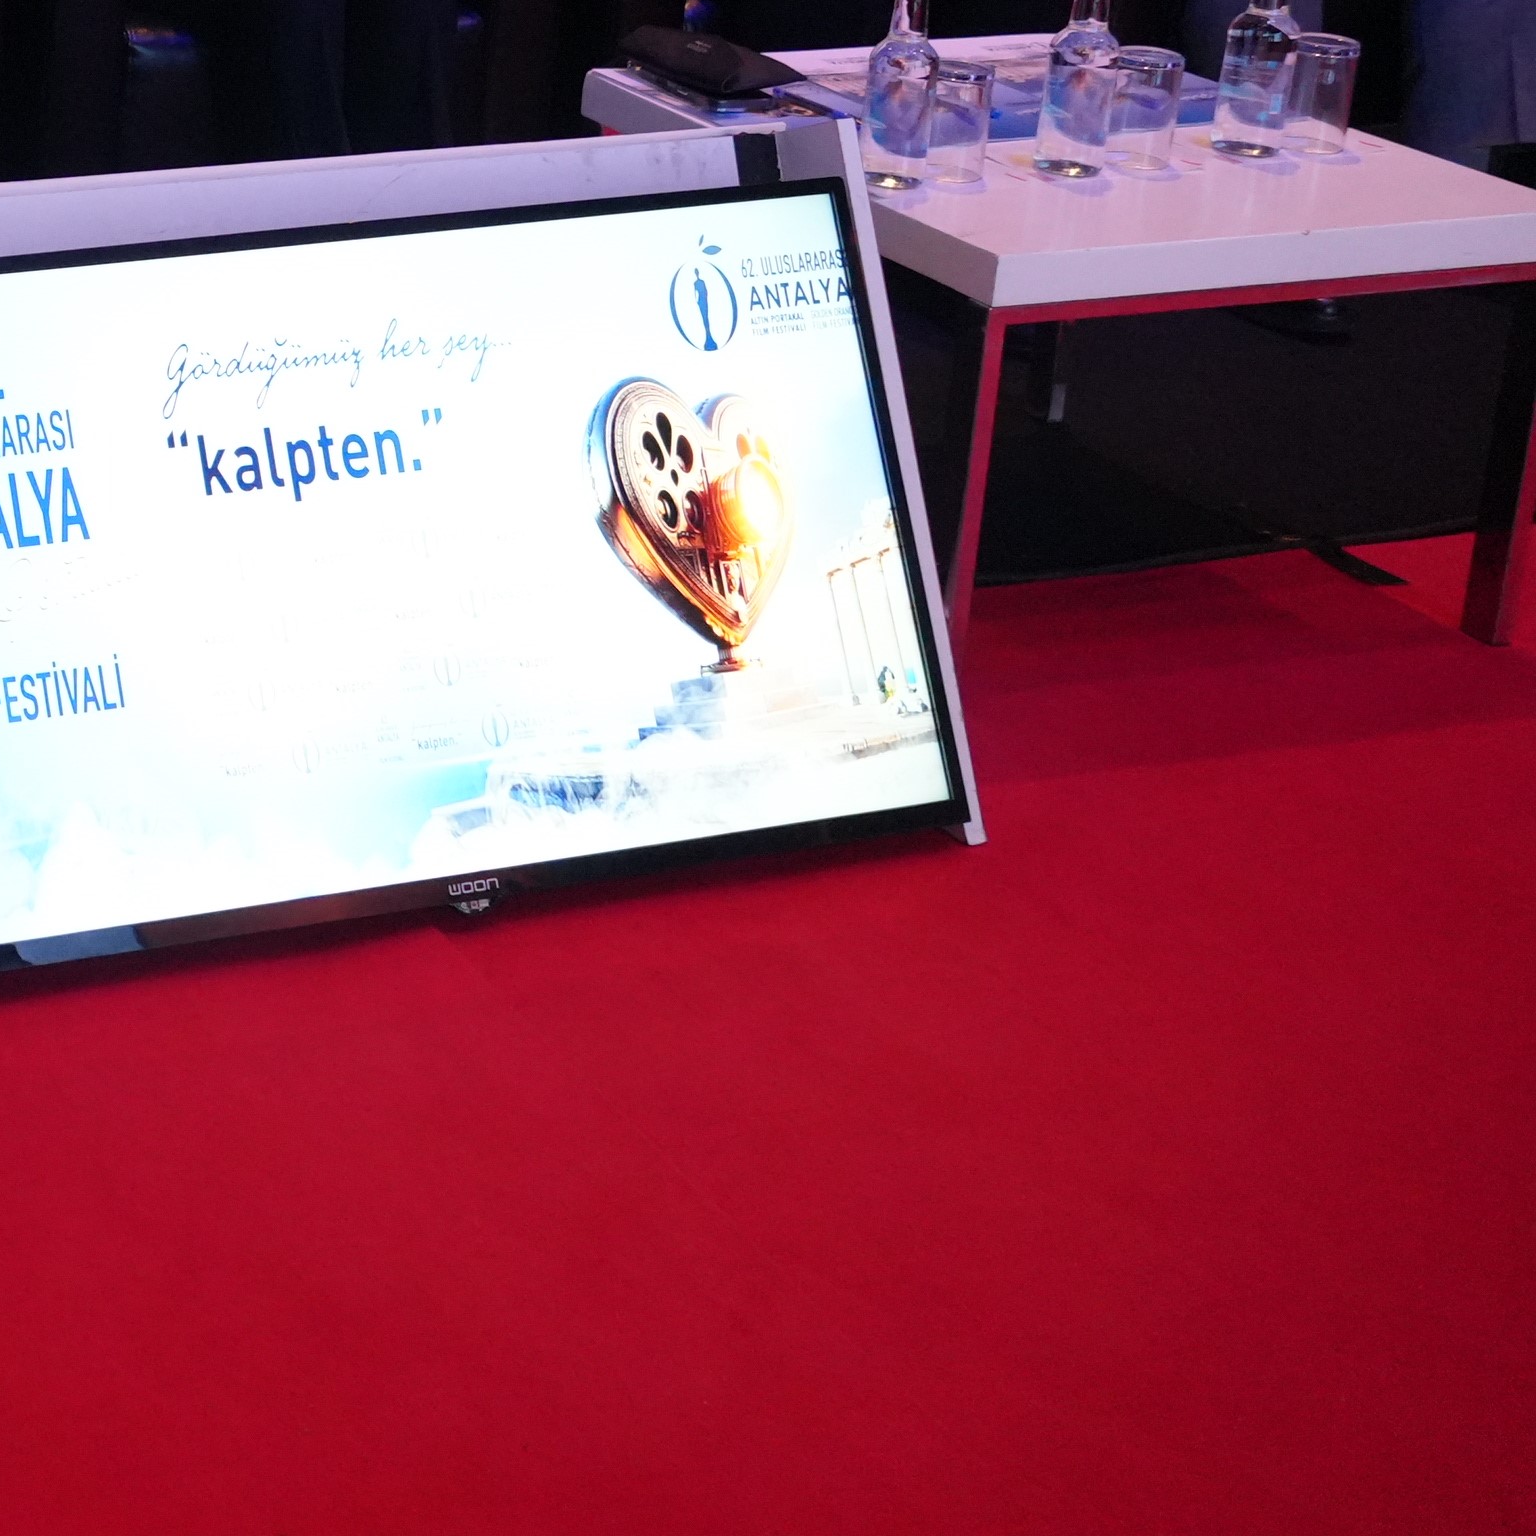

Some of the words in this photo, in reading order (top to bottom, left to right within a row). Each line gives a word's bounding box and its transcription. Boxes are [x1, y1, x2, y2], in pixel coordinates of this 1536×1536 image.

[750, 277, 852, 311] ANTALYA
[378, 318, 431, 360] her
[167, 408, 443, 502] “kalpten.”
